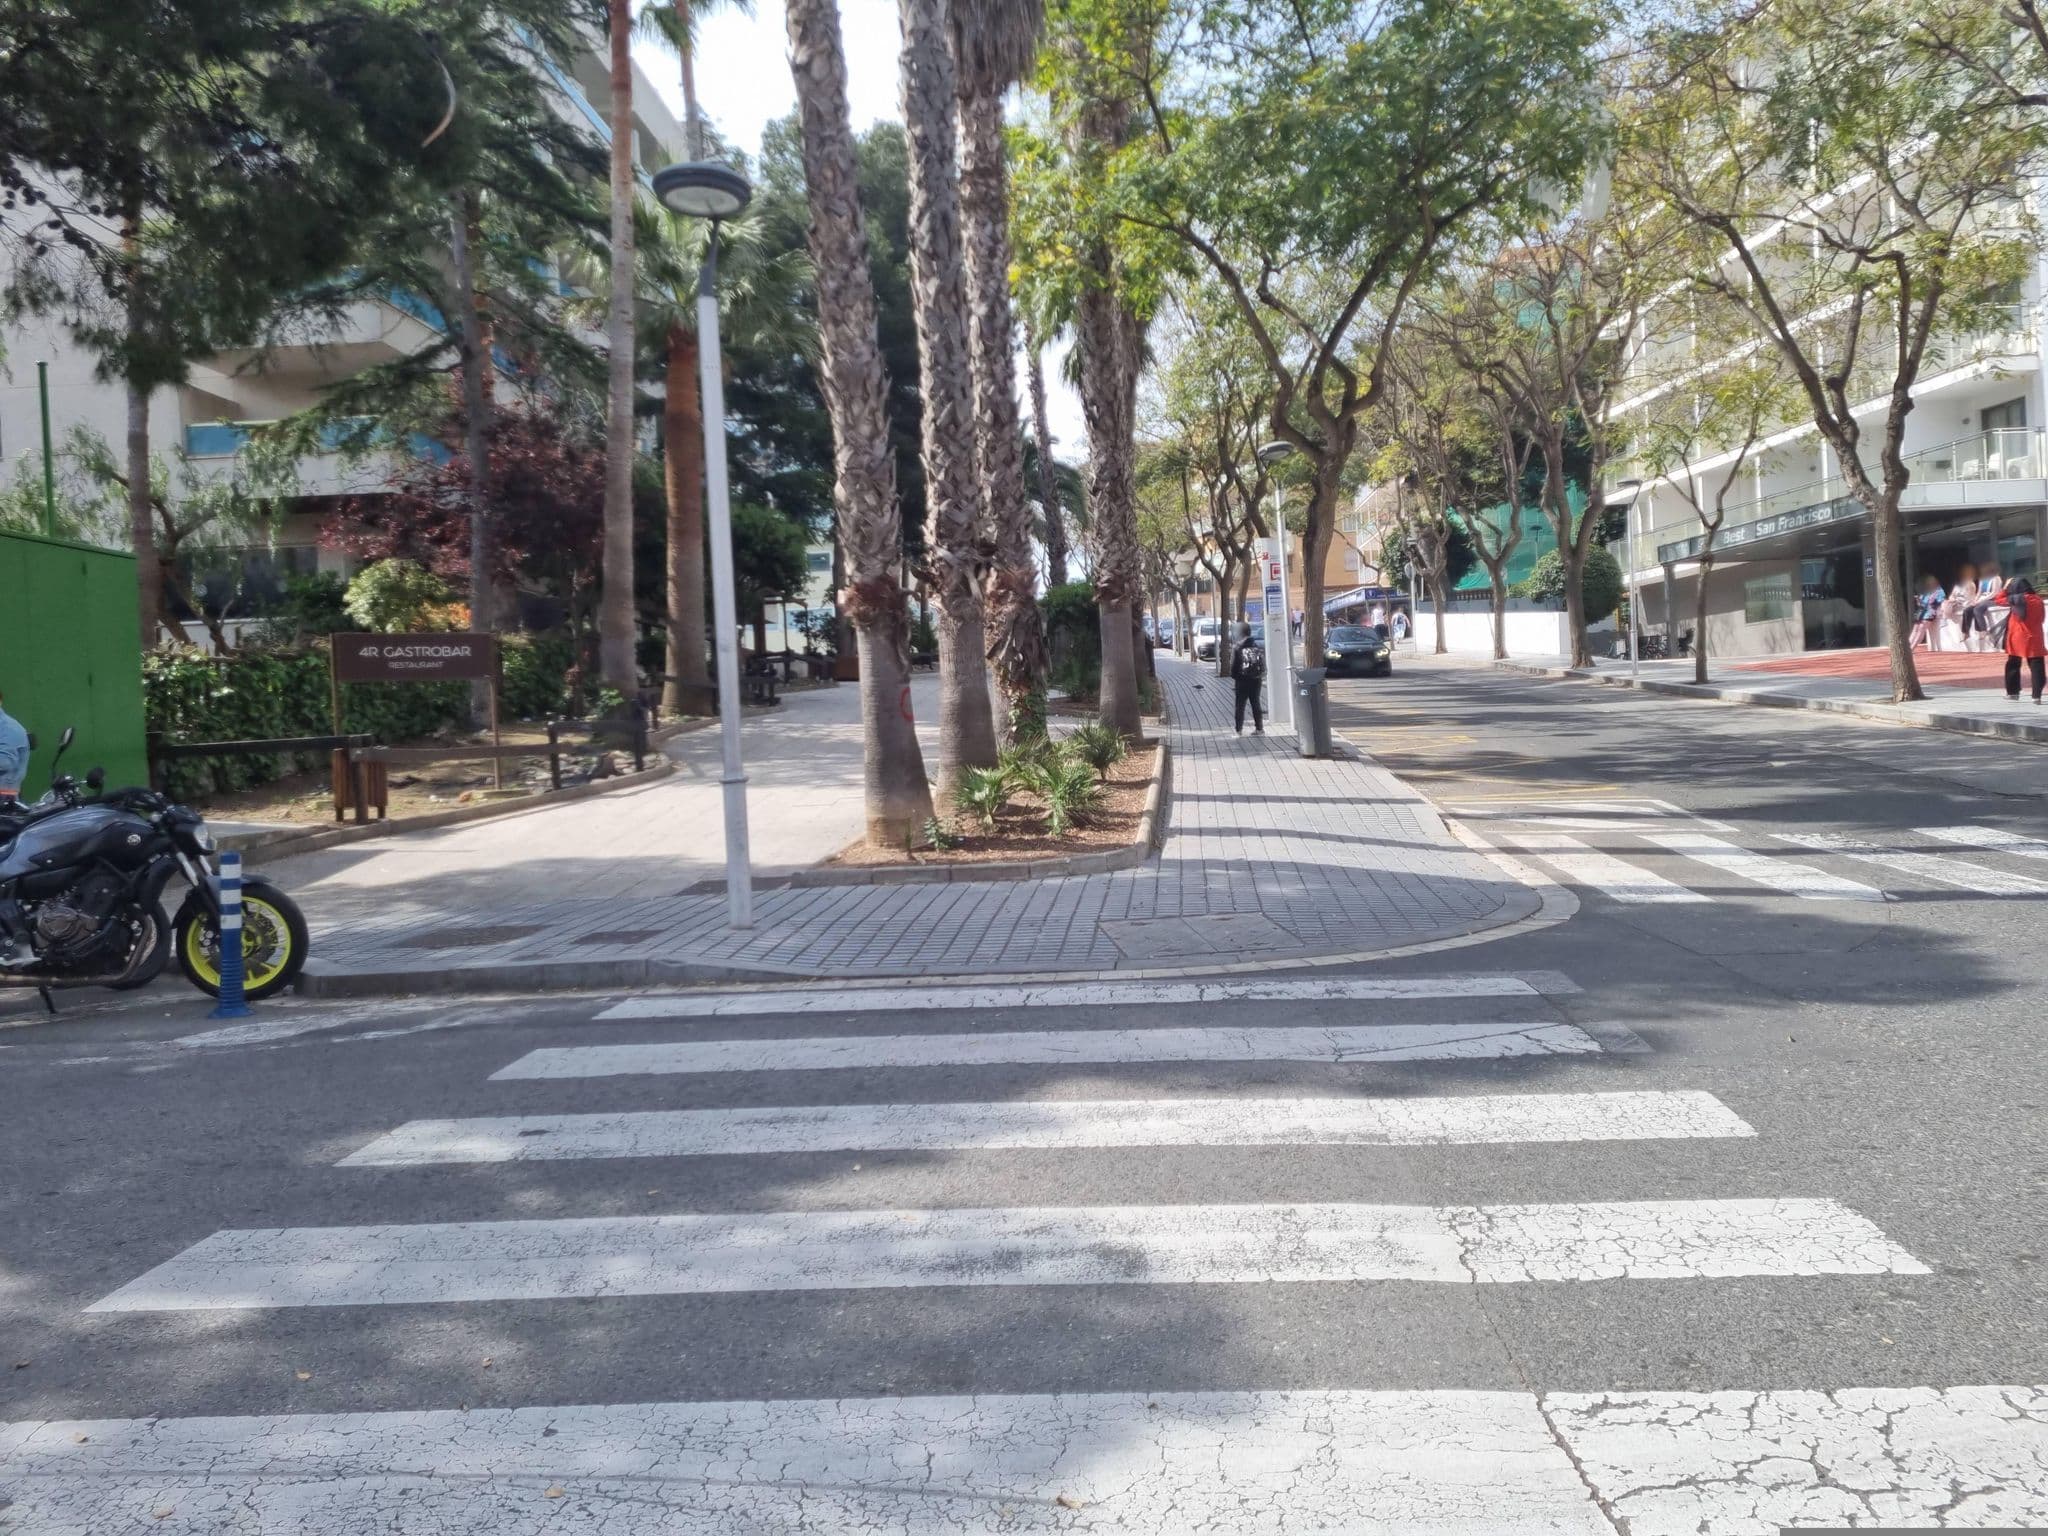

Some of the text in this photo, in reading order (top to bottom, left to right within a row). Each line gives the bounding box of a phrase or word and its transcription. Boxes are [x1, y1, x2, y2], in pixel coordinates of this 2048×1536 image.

[1723, 506, 1832, 544] Best San Francisco
[359, 646, 472, 658] 4R GASTROBAR
[388, 661, 445, 669] RESTAURANT
